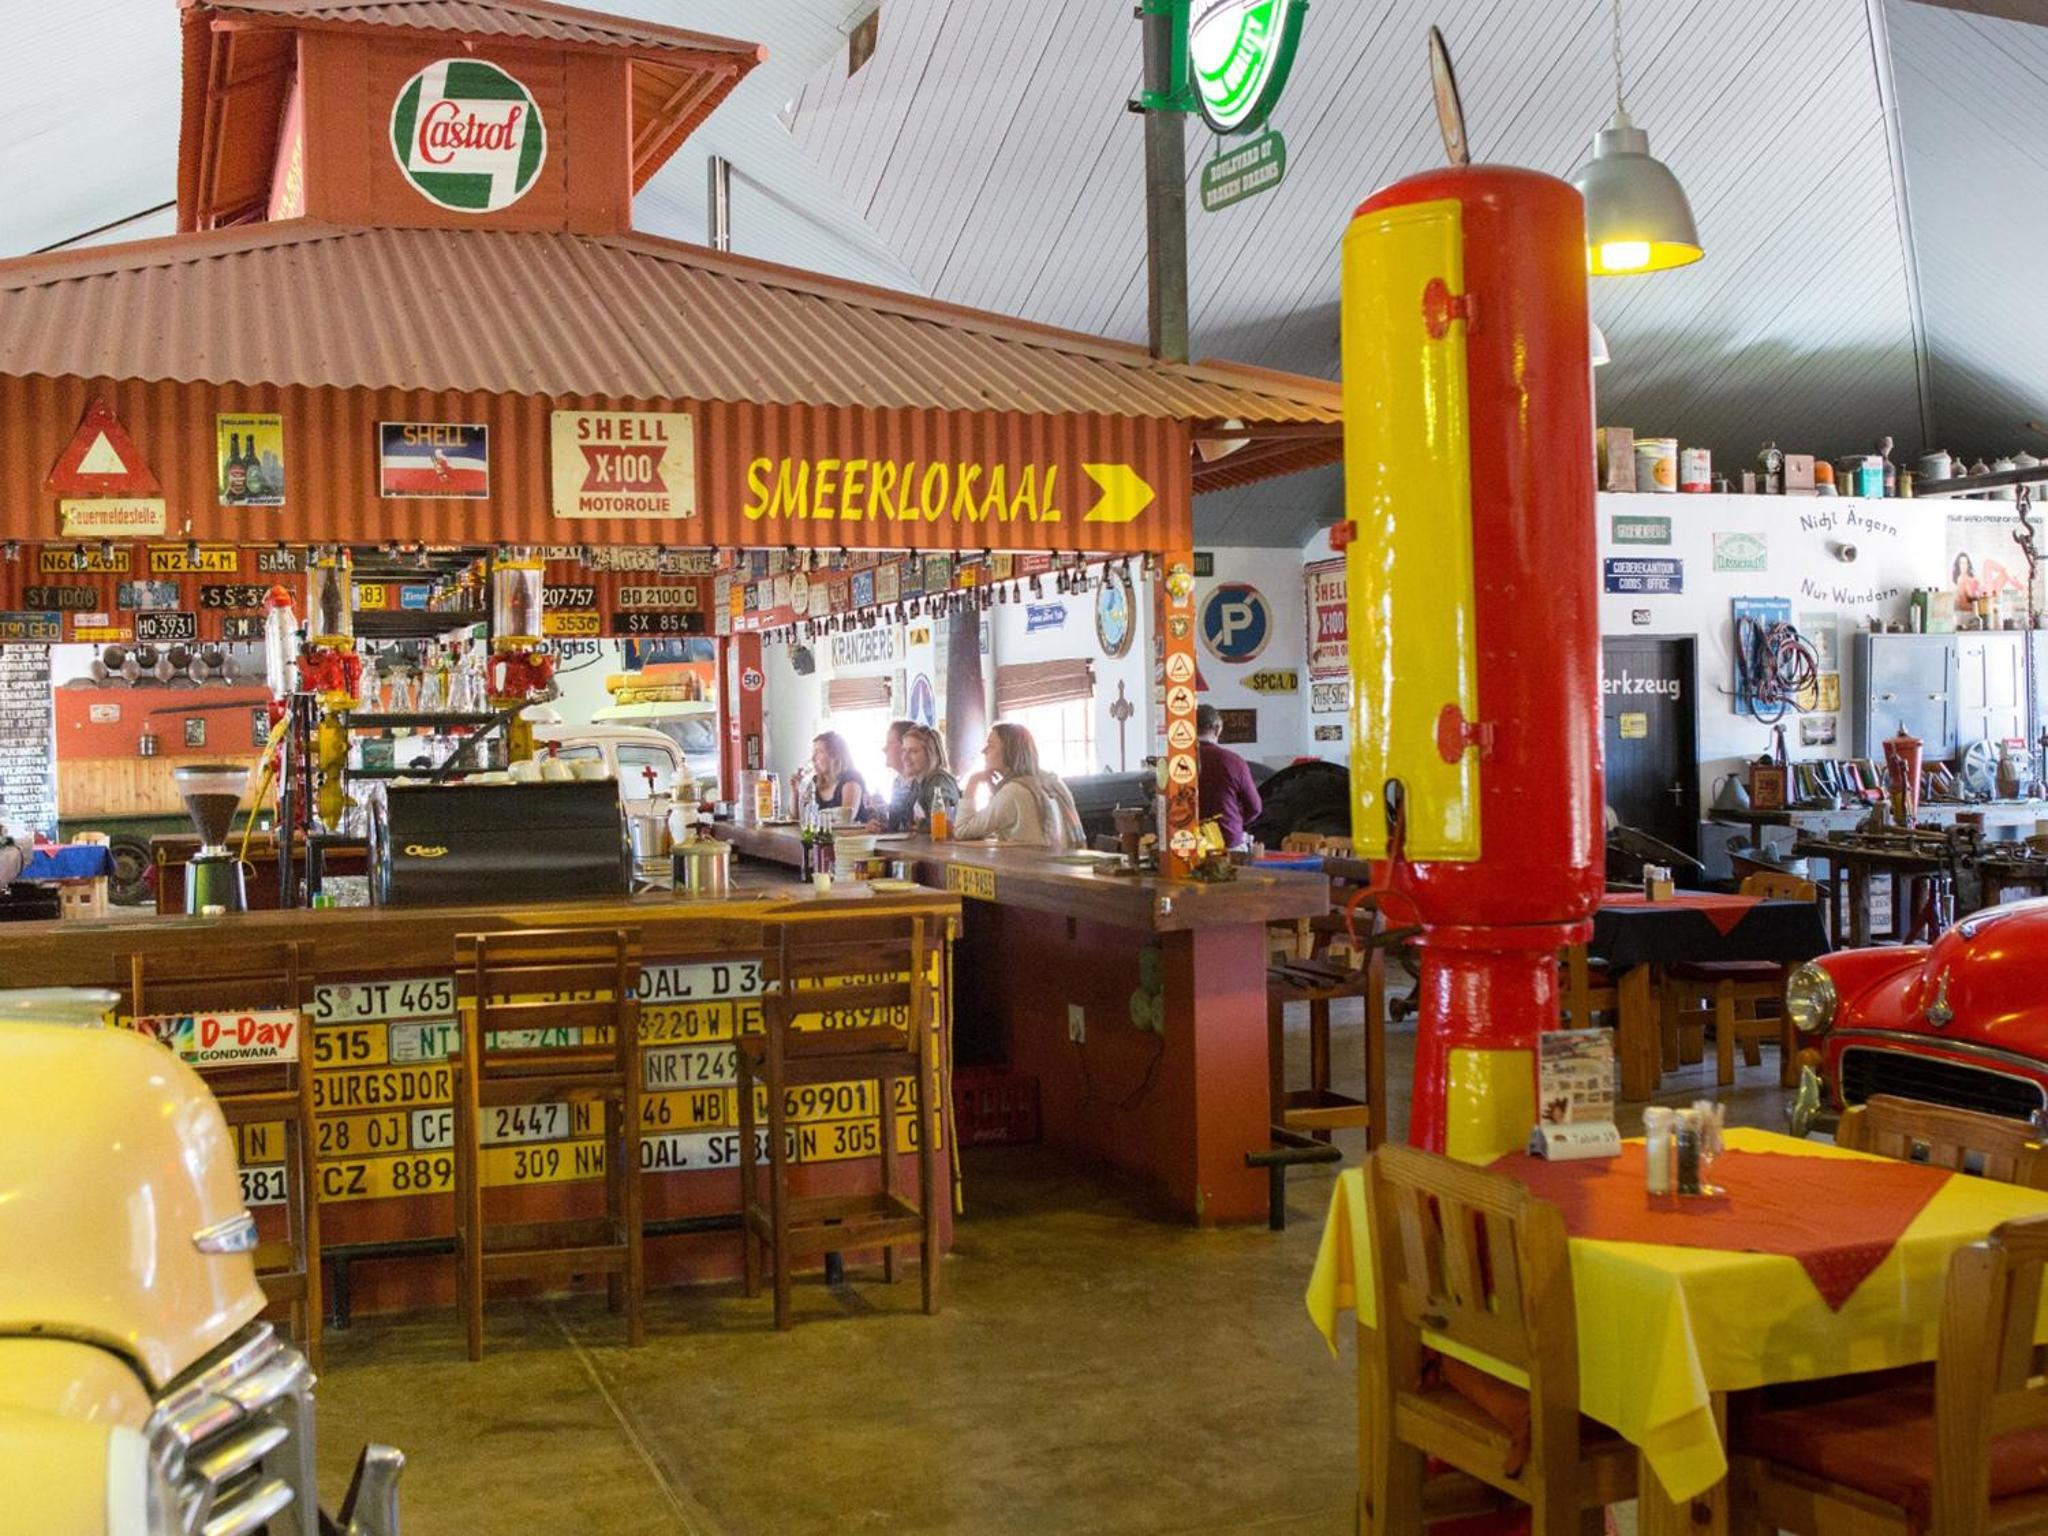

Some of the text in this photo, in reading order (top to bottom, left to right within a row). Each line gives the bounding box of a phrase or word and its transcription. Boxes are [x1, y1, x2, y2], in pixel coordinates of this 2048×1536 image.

[419, 100, 522, 165] Castrol
[404, 425, 468, 448] SHELL
[577, 417, 669, 441] SHELL
[596, 454, 652, 484] X-100
[578, 497, 671, 512] MOTOROLIE
[743, 457, 1062, 522] SMEERLOKAAL
[646, 588, 681, 605] 2100
[1647, 578, 1670, 590] OFFICE
[1801, 578, 1828, 600] Nur
[160, 617, 193, 635] 3931
[660, 614, 689, 631] 854
[1221, 603, 1254, 646] P
[744, 673, 761, 685] 50
[1599, 668, 1681, 700] erkzeug
[713, 966, 730, 995] D
[317, 981, 450, 1018] S JT 465
[201, 1016, 293, 1049] D-Day
[314, 1030, 370, 1061] 515
[420, 1025, 460, 1056] NT
[200, 1047, 278, 1061] GONDWANA
[692, 1094, 721, 1122] WB
[784, 1085, 867, 1116] 69901
[496, 1105, 558, 1138] 2447
[576, 1105, 590, 1130] N
[251, 1126, 266, 1157] N
[318, 1118, 350, 1150] 28
[803, 1130, 816, 1157] N
[834, 1123, 876, 1153] 305
[708, 1134, 740, 1165] SF
[322, 1157, 452, 1197] CZ 889
[514, 1150, 560, 1180] 309
